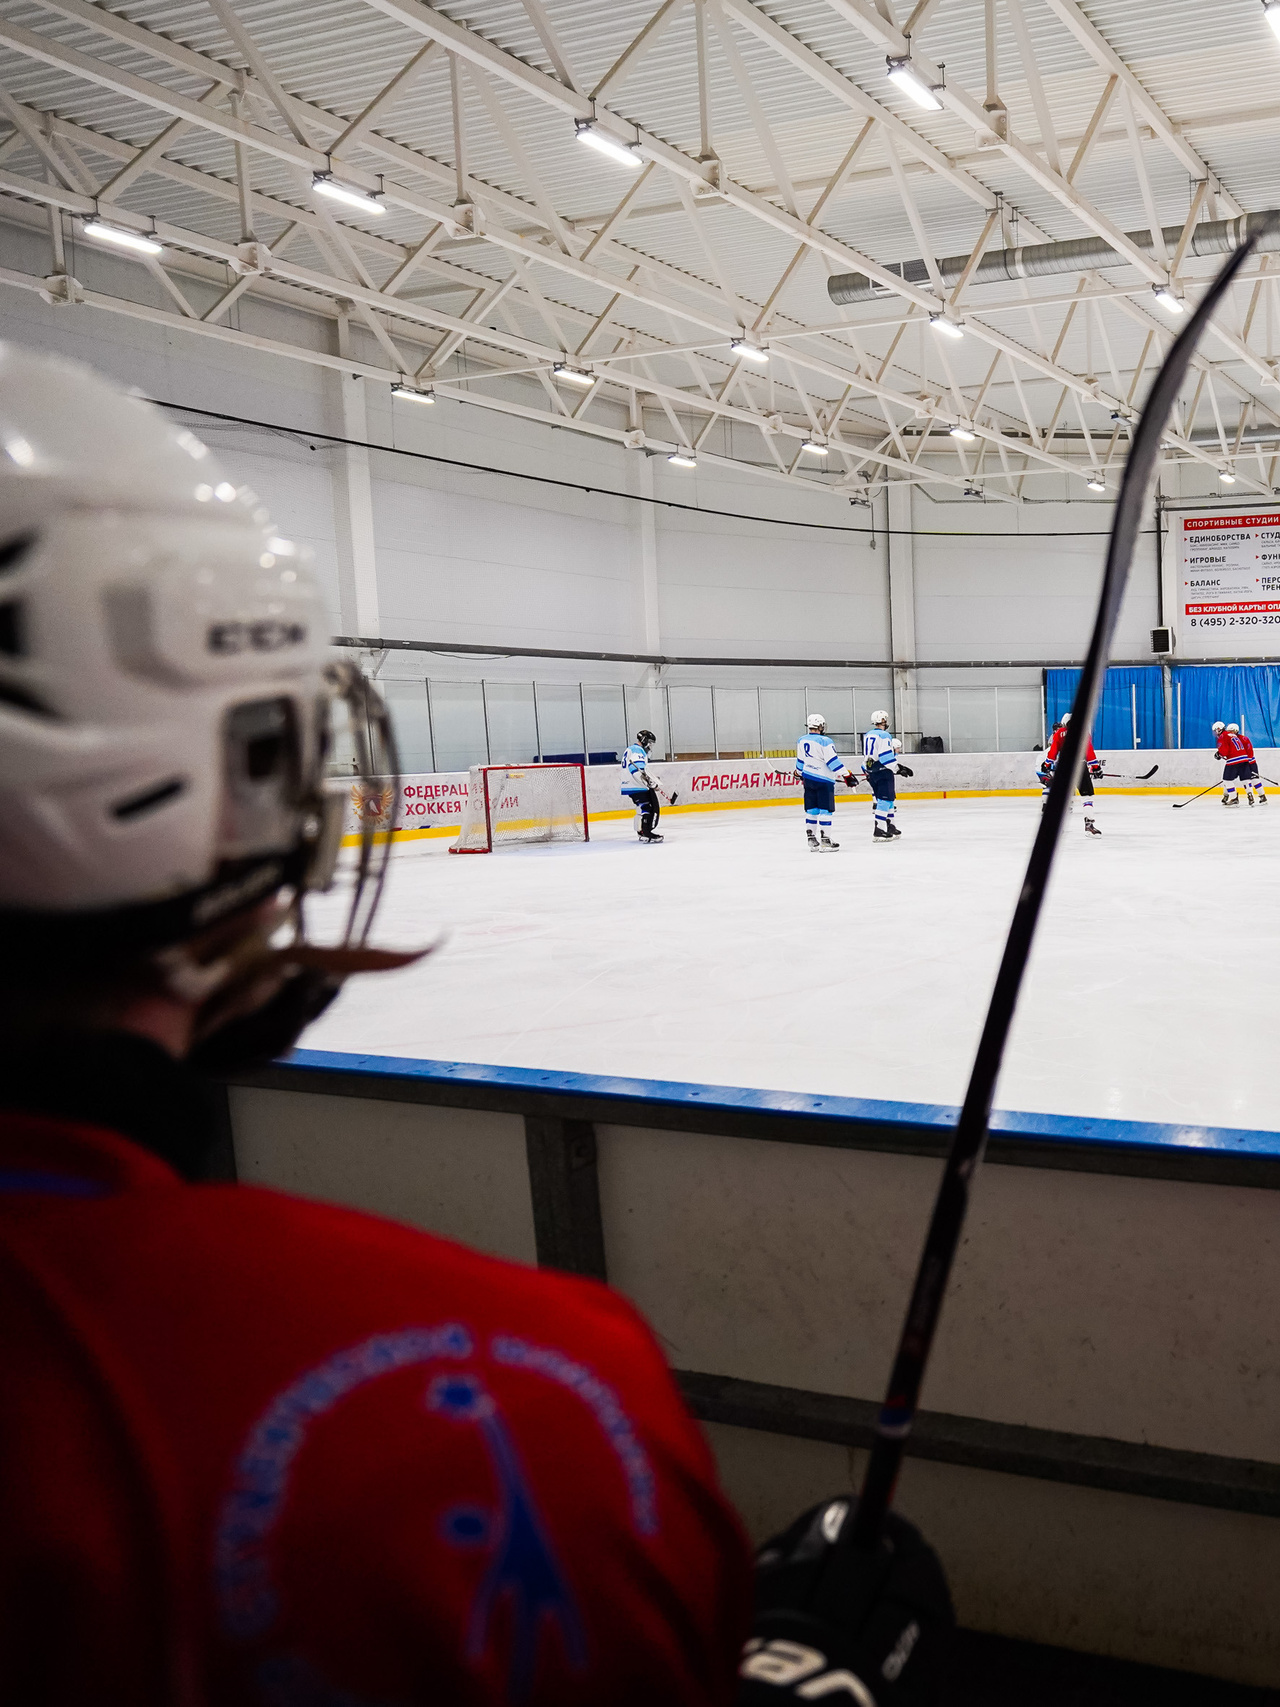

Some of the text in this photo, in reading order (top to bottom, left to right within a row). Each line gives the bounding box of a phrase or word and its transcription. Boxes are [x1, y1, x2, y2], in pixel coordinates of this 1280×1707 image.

[1187, 518, 1243, 528] СПОРТИВНЫЕ
[1246, 516, 1279, 524] СТУДИИ
[1189, 533, 1251, 543] ЕДИНОБОРСТВА
[1190, 579, 1221, 587] БАЛАНС
[1203, 604, 1237, 612] КЛУБНОЙ
[1190, 615, 1280, 627] 8 (495) 2-320-320
[691, 772, 804, 792] КРАСНАЯ МАШИ
[405, 800, 462, 816] ХОККЕЯ
